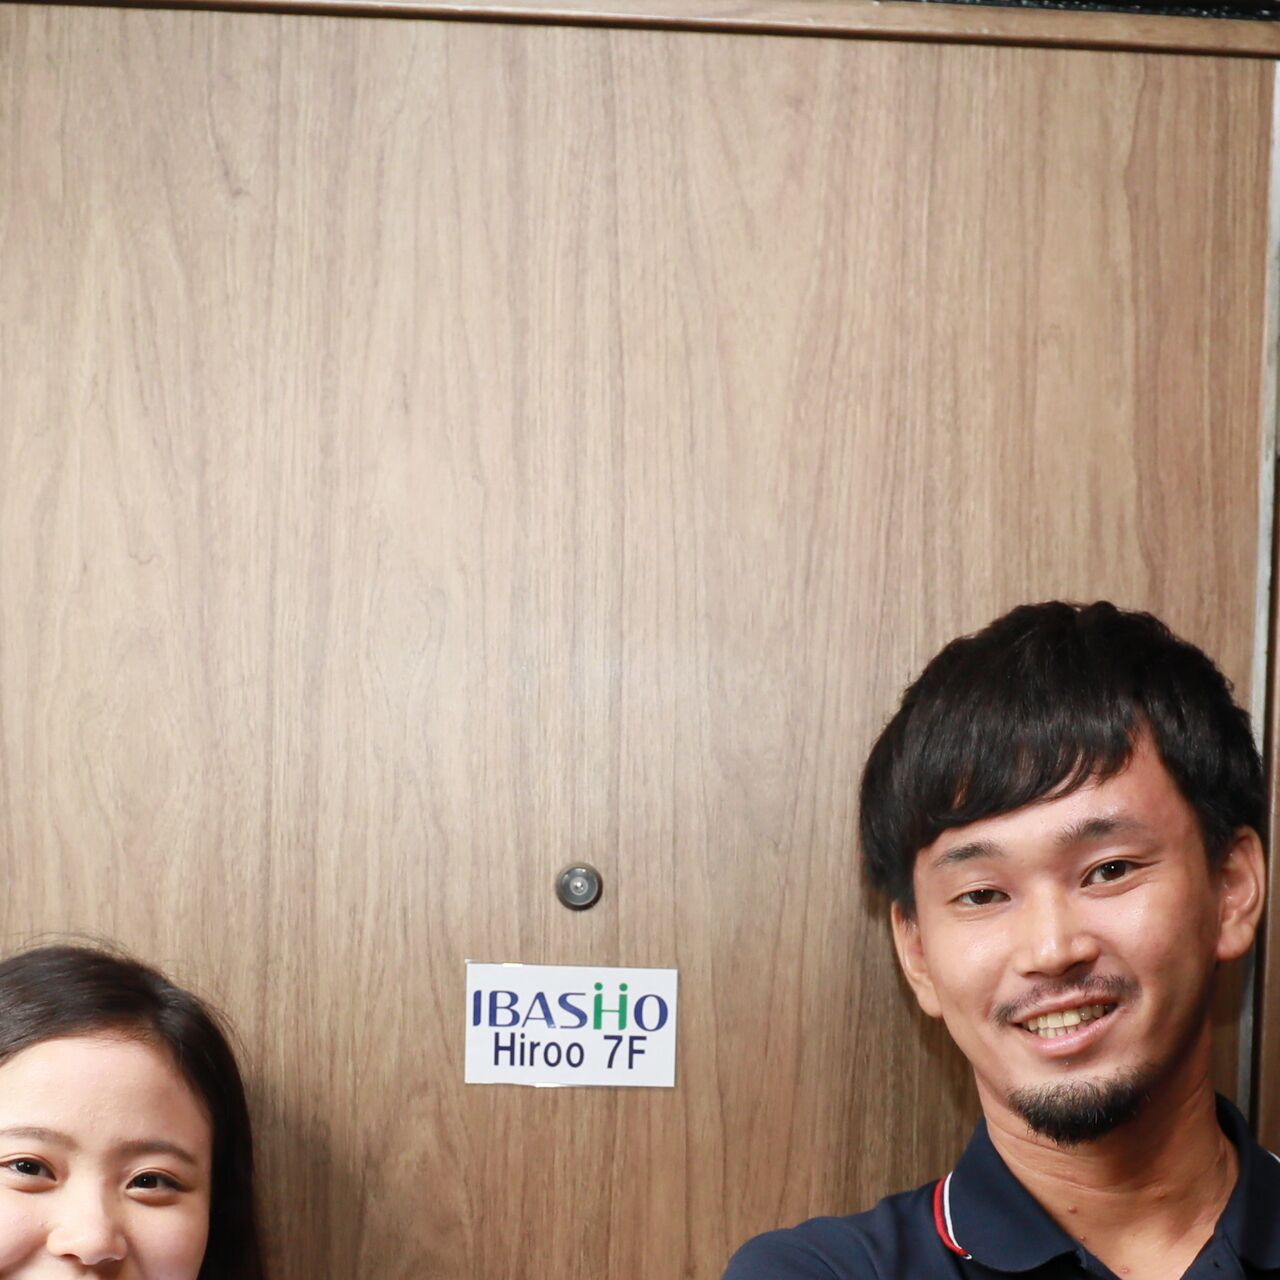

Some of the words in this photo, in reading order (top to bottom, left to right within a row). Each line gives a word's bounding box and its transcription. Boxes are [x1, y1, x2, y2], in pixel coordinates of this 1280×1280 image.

[472, 982, 669, 1032] IBASHO
[493, 1032, 585, 1068] Hiroo
[603, 1035, 647, 1069] 7F
